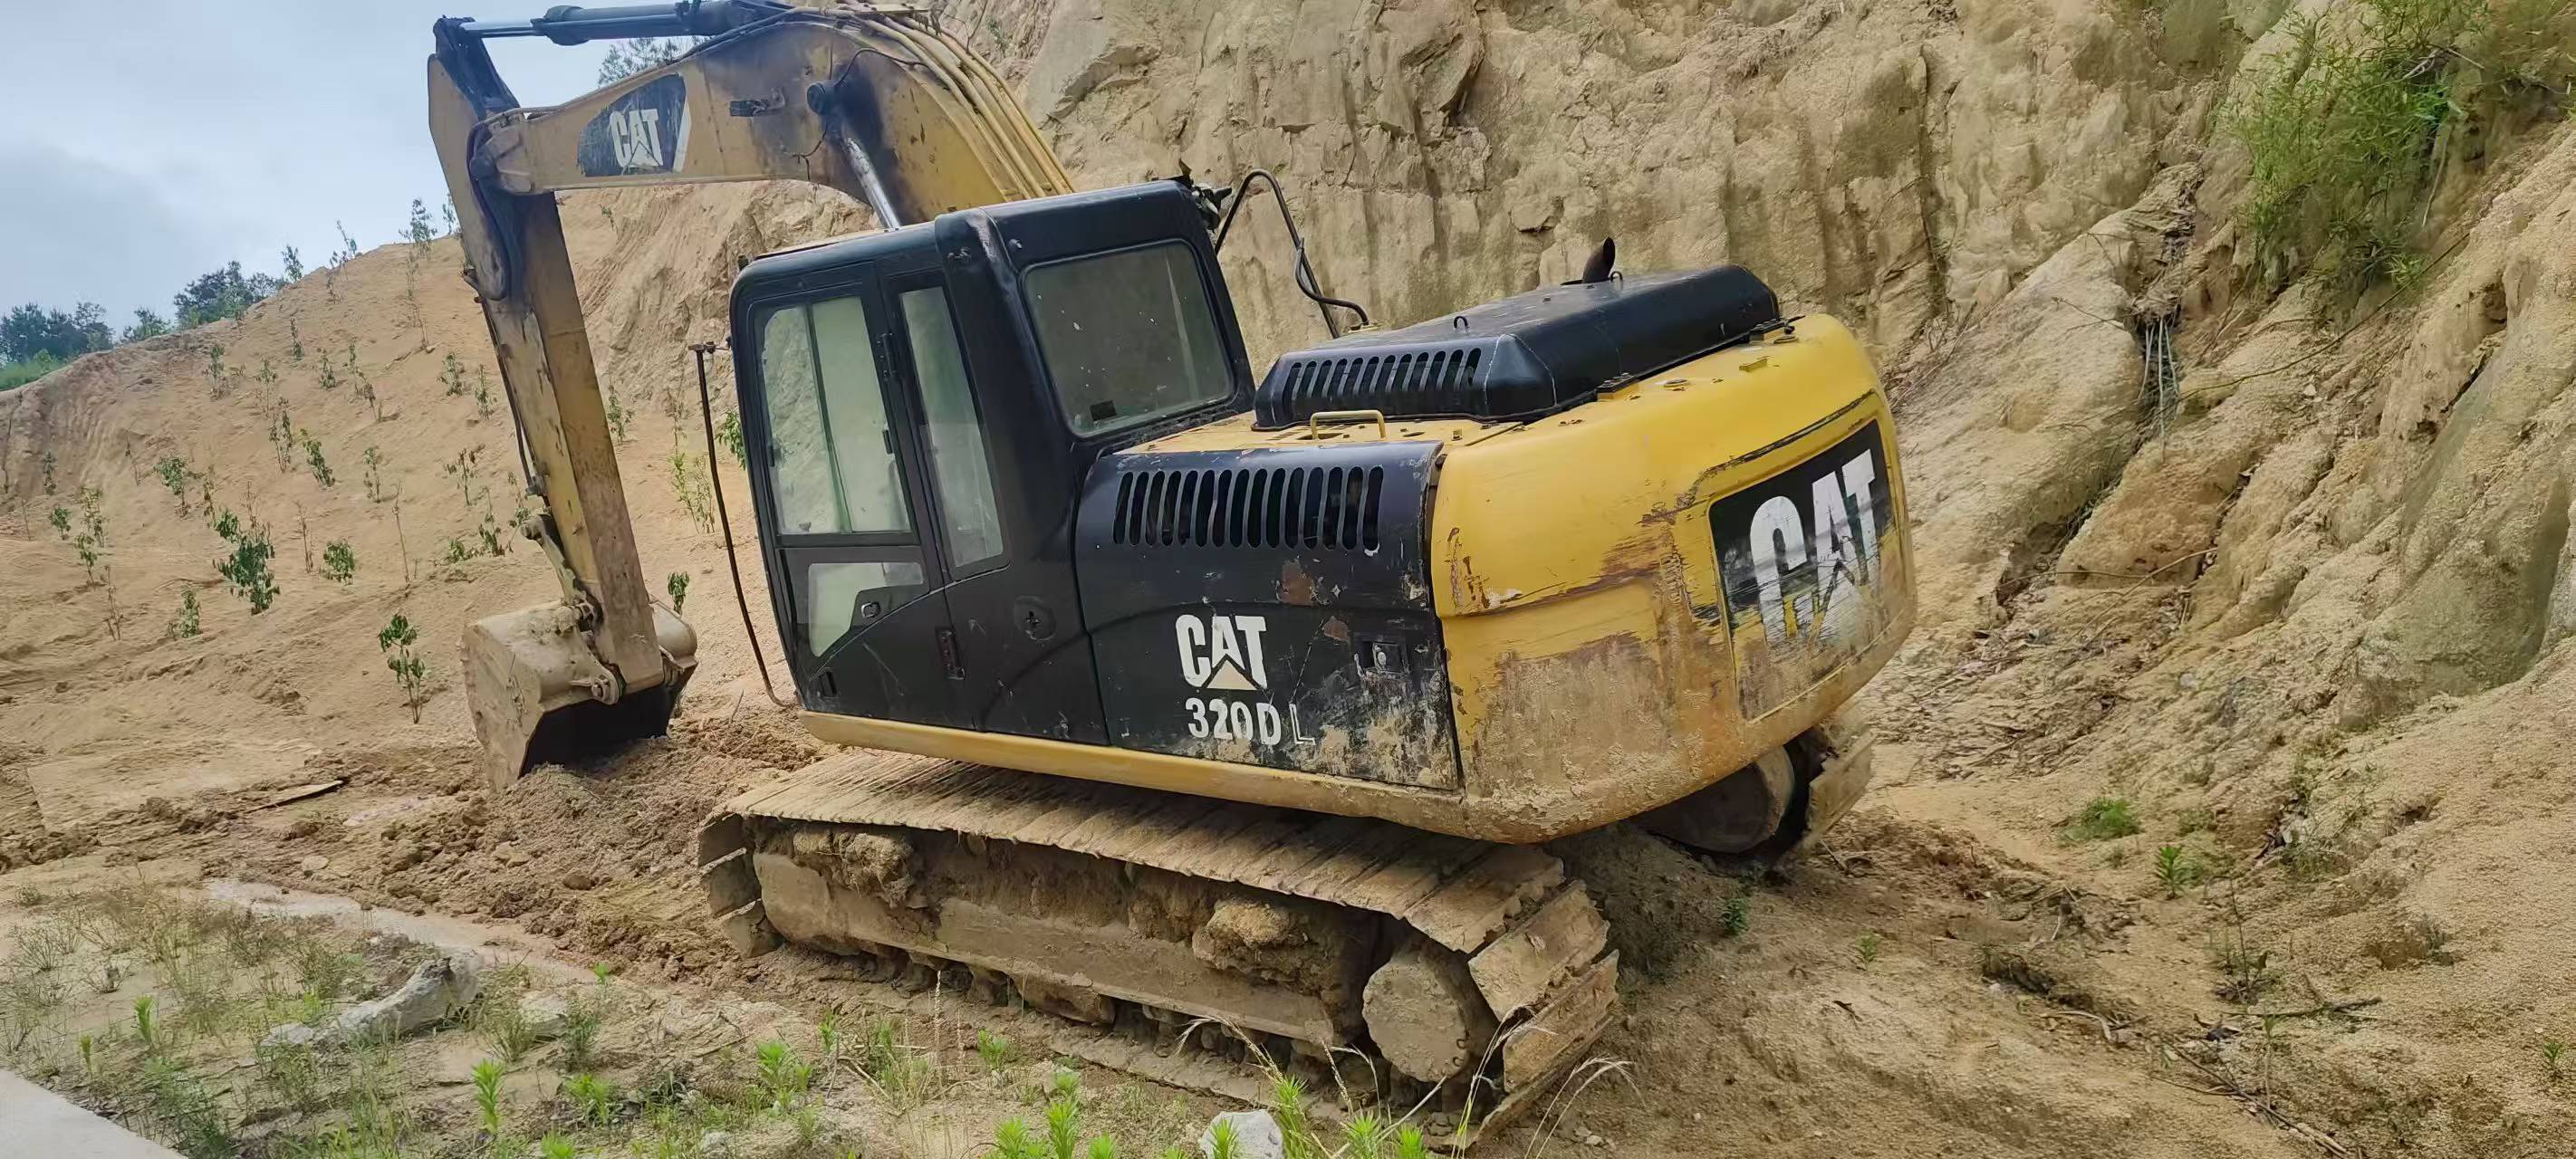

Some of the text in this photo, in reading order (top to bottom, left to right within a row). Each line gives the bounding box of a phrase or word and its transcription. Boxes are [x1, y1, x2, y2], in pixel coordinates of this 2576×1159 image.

[609, 108, 663, 168] CAT
[1749, 449, 1883, 647] CAT
[1176, 614, 1268, 690] CAT
